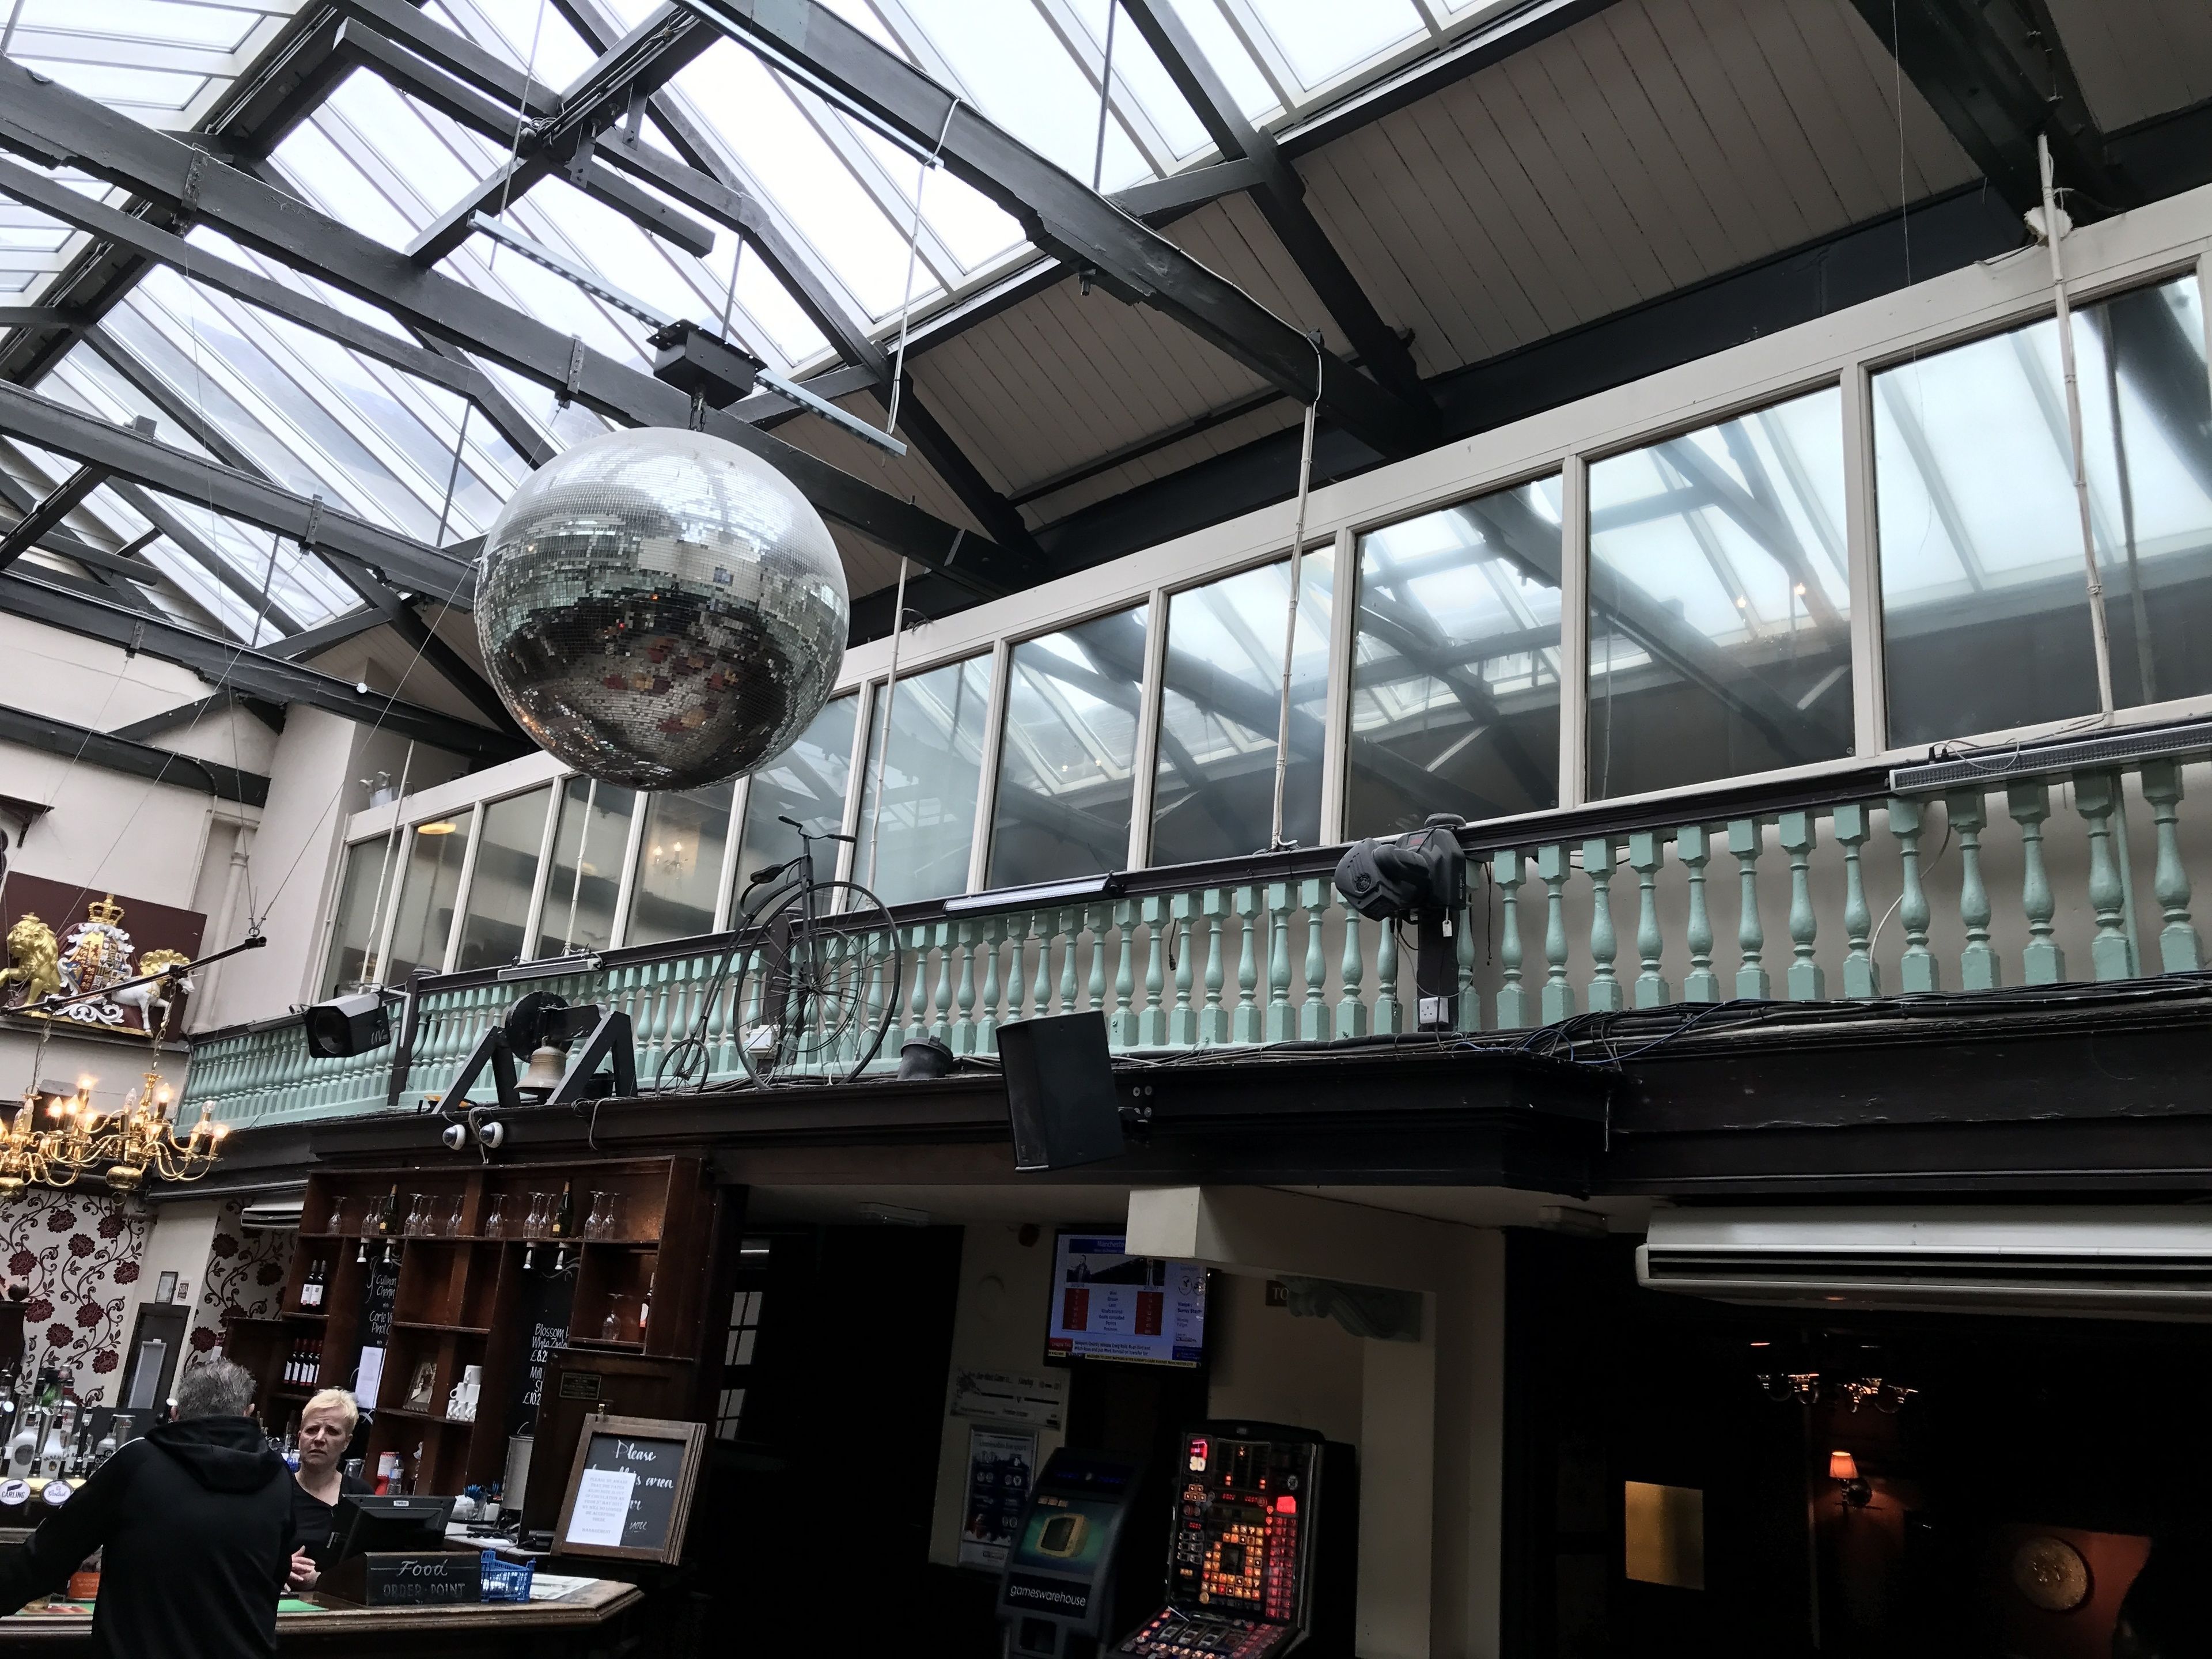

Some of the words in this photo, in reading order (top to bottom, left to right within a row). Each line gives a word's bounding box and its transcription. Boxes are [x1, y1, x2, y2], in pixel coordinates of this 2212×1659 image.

[535, 1323, 565, 1340] Blossom
[613, 1440, 657, 1461] Please
[645, 1477, 674, 1489] area
[396, 1559, 448, 1577] Food
[383, 1584, 422, 1597] ORDER
[431, 1584, 466, 1597] POINT
[1010, 1586, 1086, 1607] gameswarehouse
